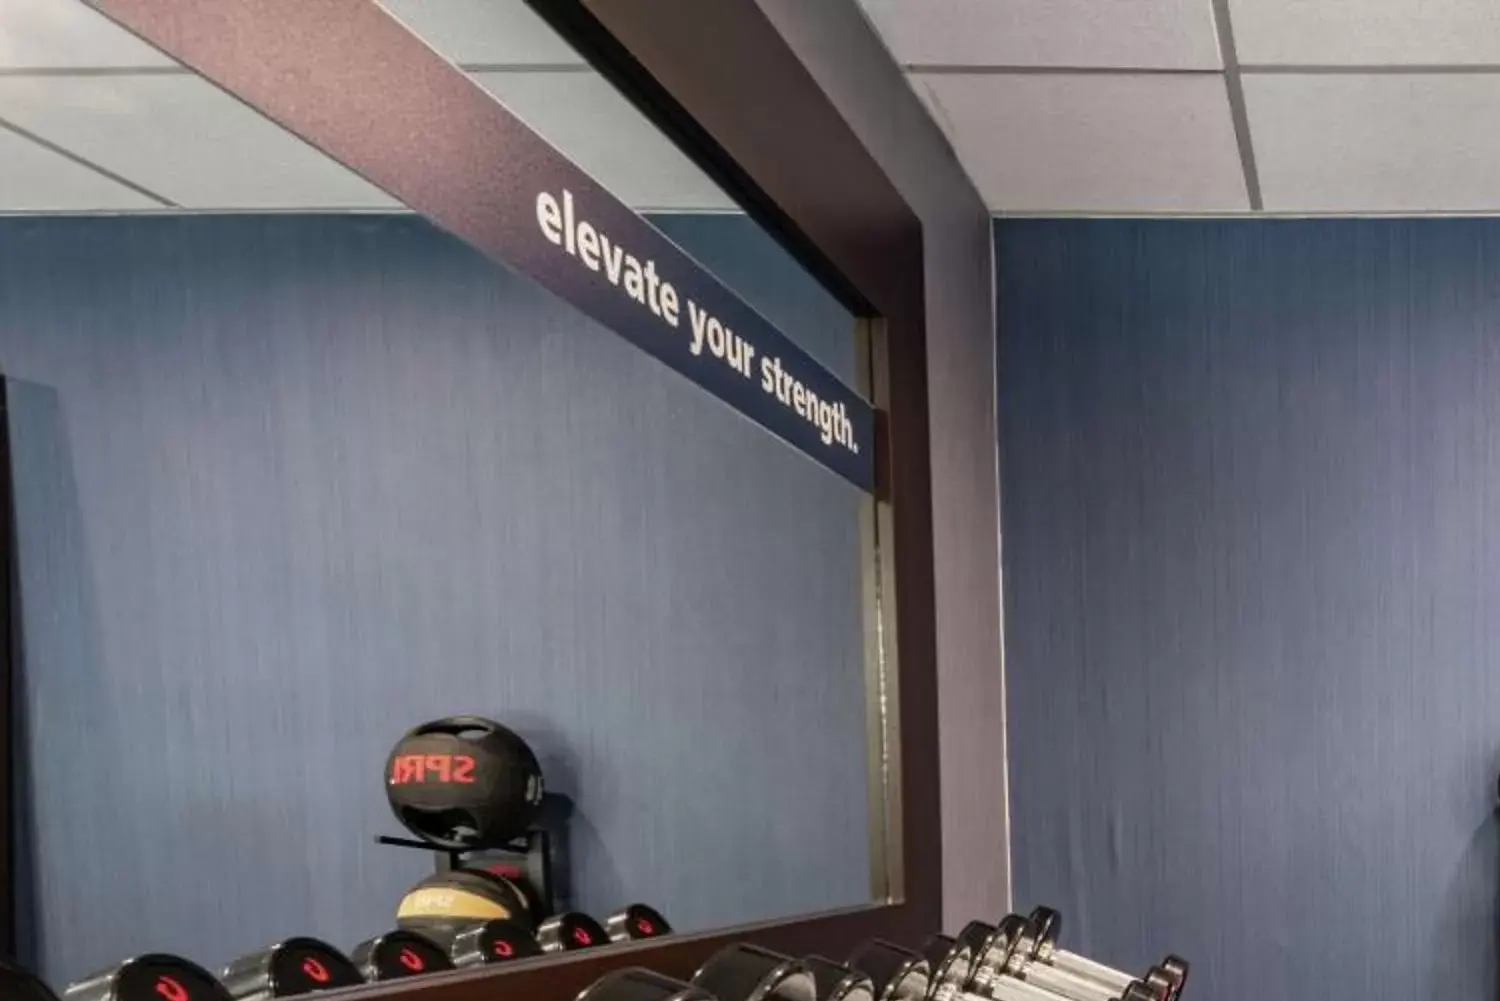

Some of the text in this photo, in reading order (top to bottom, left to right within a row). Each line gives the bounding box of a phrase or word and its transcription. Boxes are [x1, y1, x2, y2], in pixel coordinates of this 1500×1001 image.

[536, 189, 859, 454] elevate your strength.
